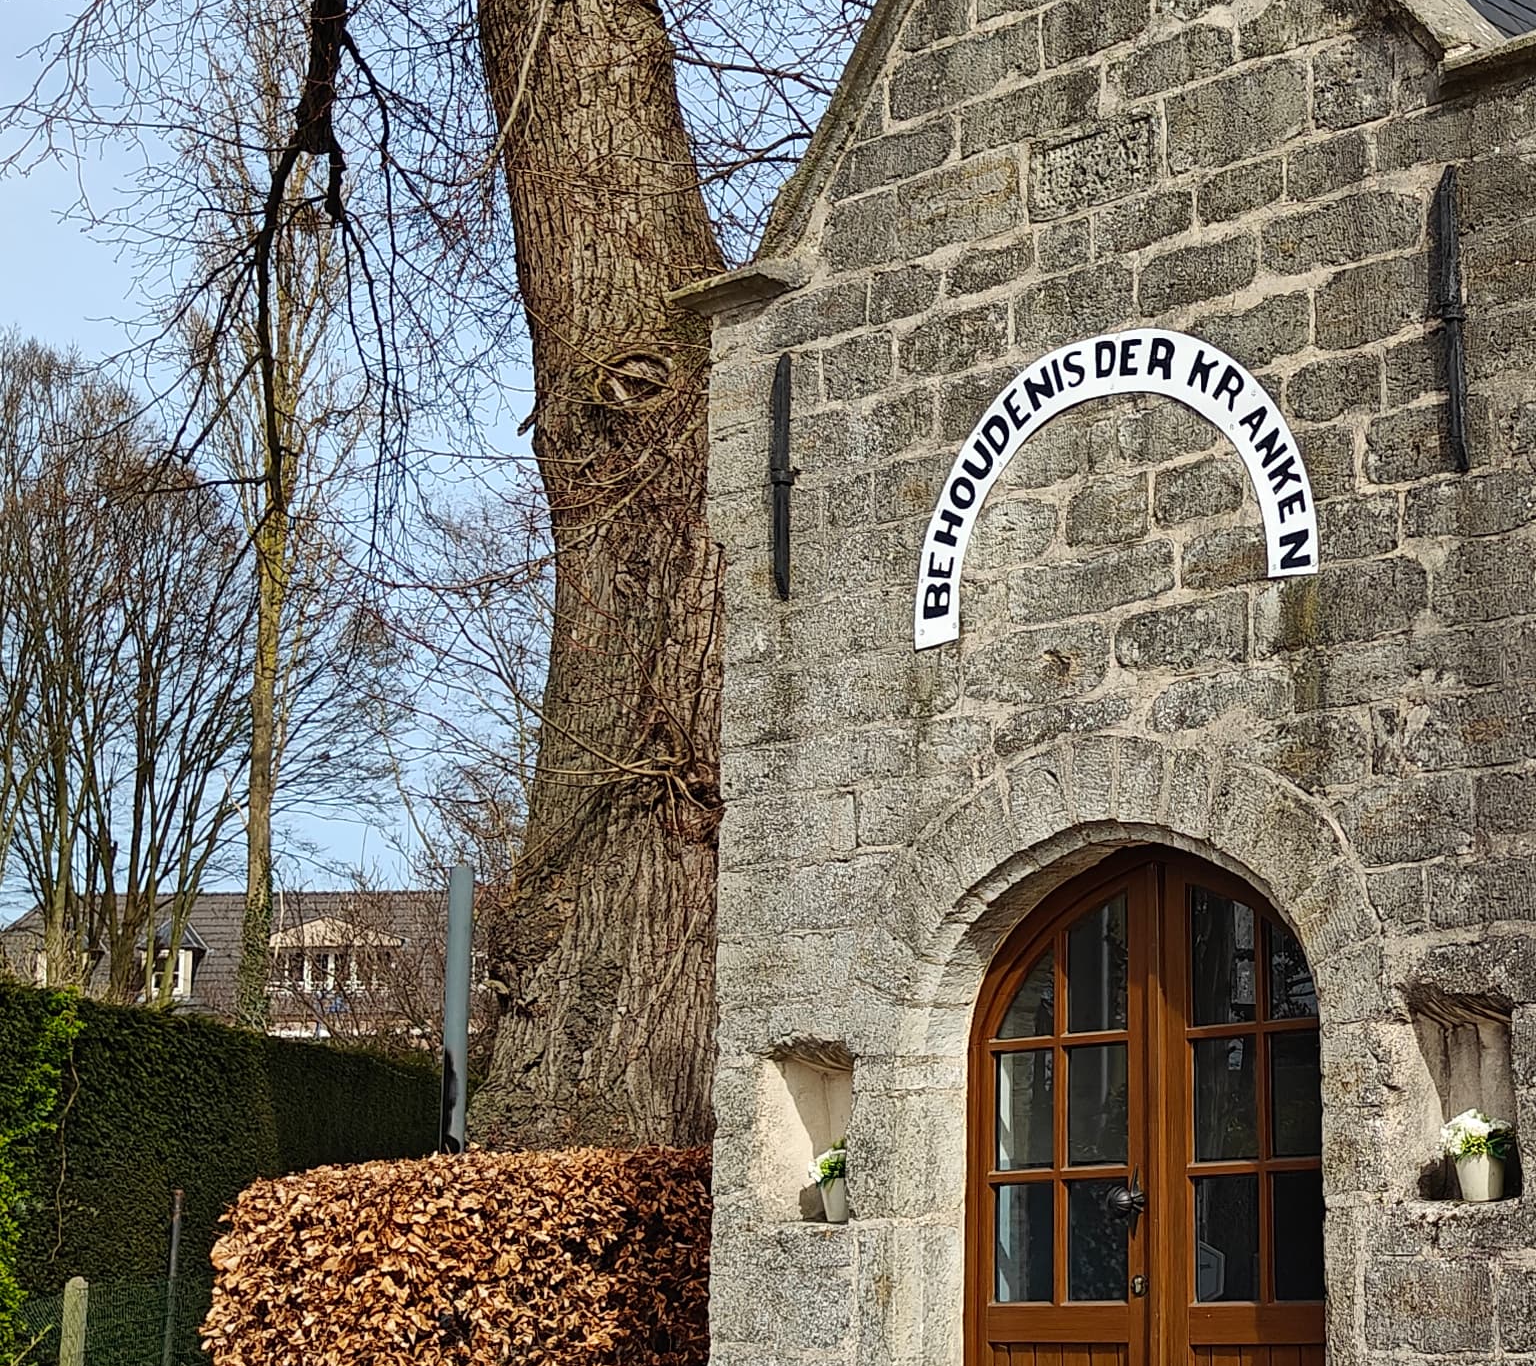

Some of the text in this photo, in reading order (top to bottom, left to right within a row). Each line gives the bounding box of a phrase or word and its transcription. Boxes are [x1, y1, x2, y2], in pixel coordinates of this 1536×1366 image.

[923, 338, 1312, 620] BEHOUDENIS DER KRANKEN
